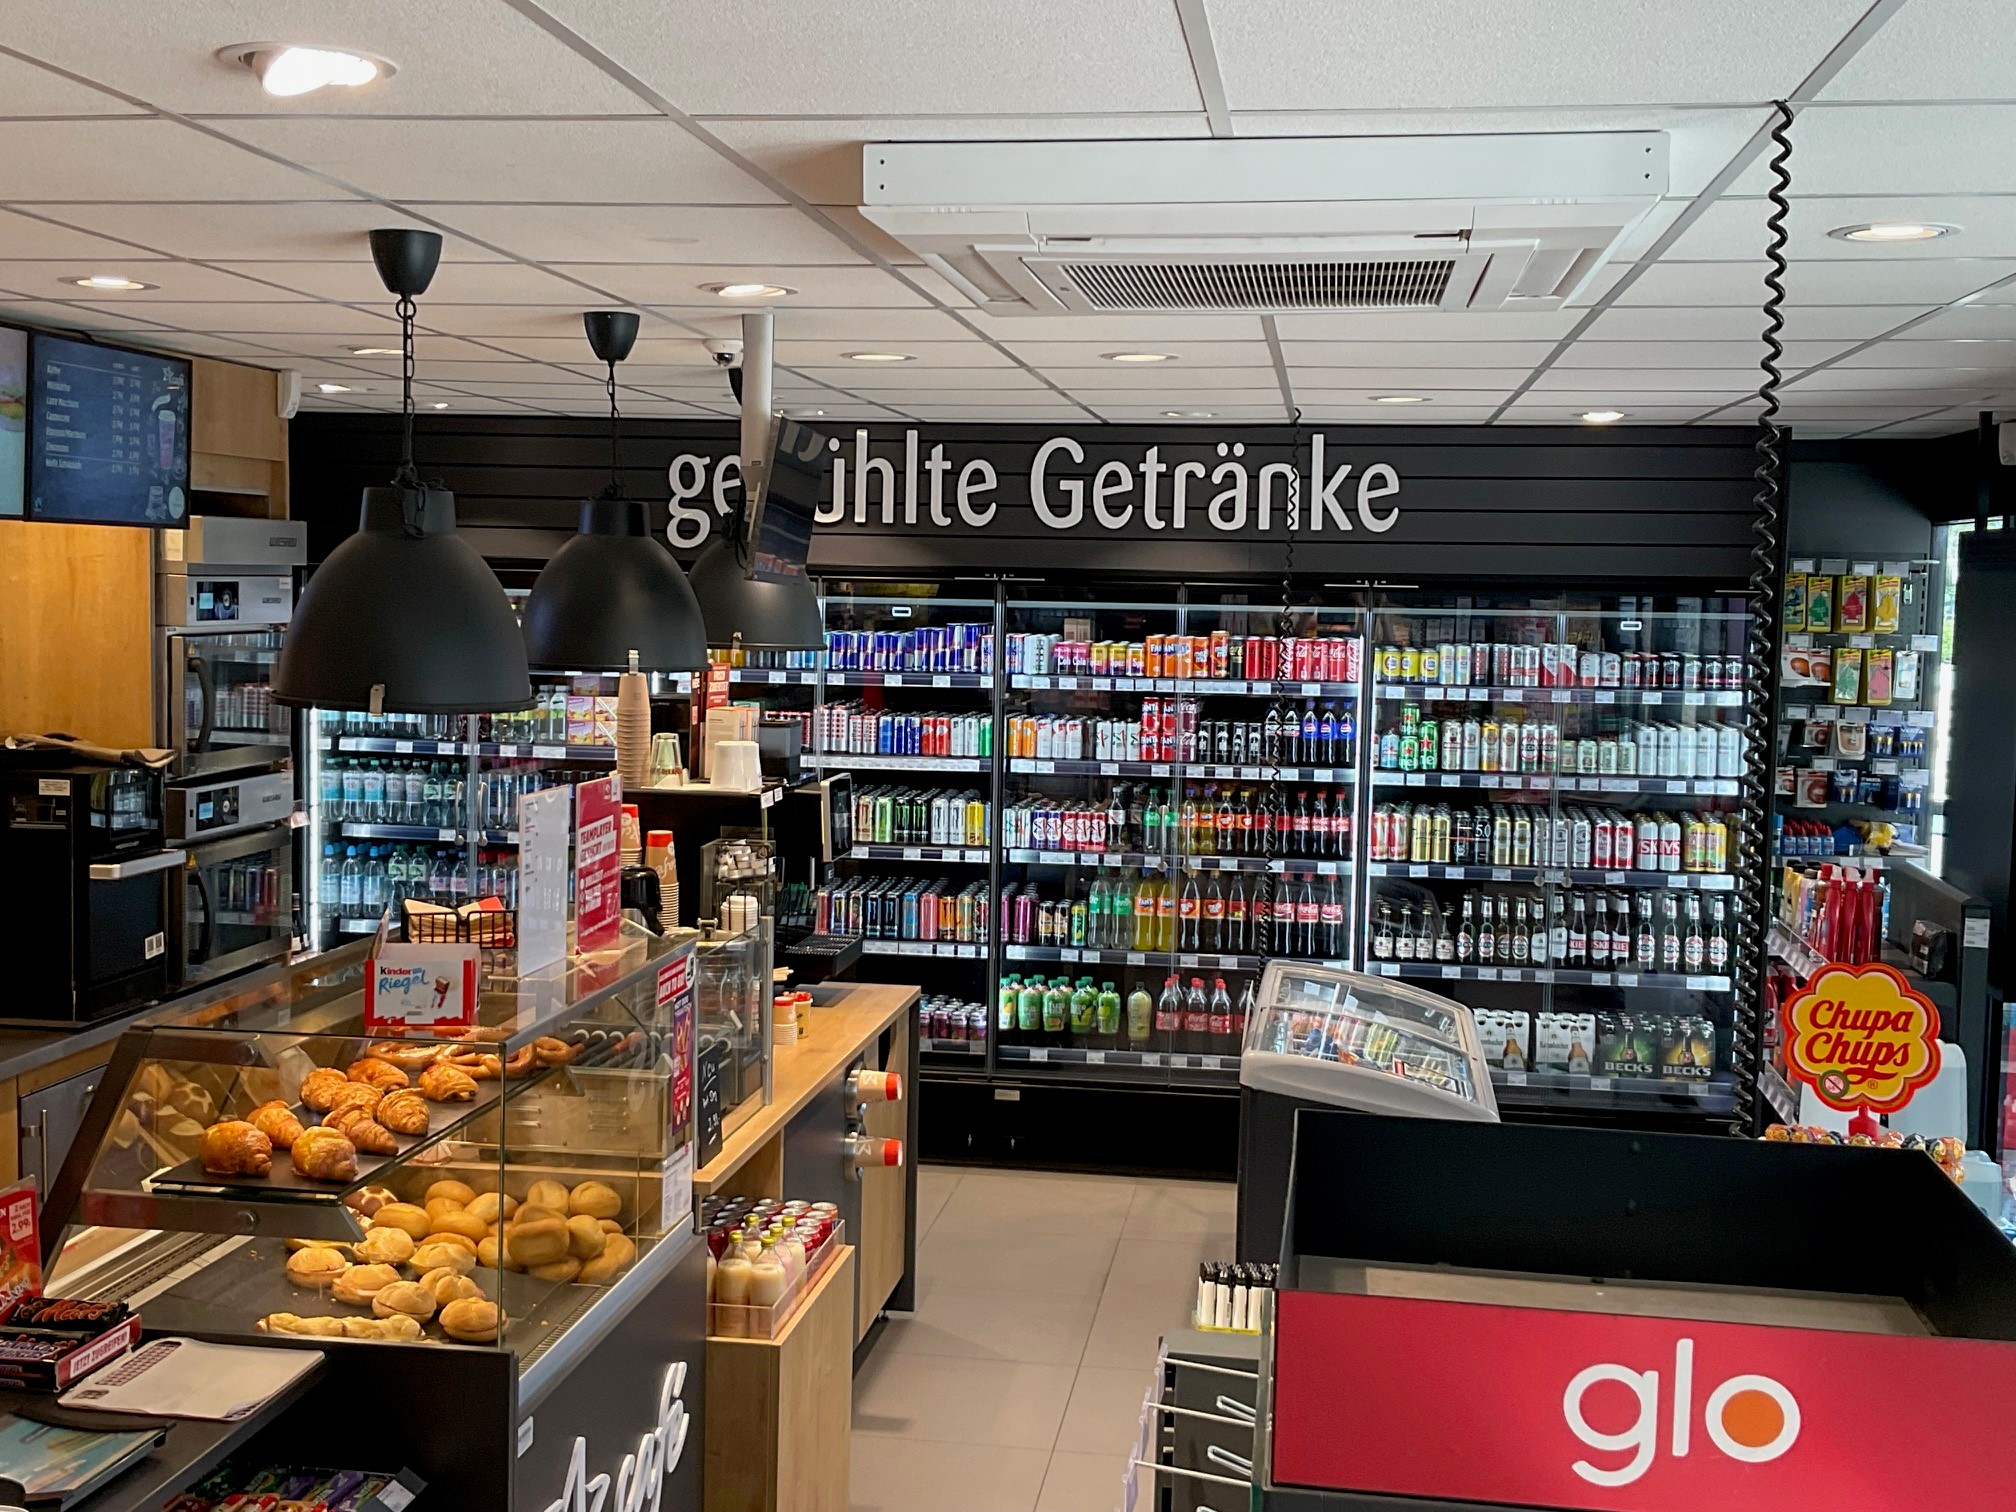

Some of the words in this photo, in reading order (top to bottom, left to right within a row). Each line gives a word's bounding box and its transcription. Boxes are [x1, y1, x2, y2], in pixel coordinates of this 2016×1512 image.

[1030, 432, 1401, 534] Getränke
[378, 969, 430, 996] Riegel
[1809, 999, 1914, 1040] Chupa
[1605, 1061, 1653, 1074] BECK'S
[1662, 1064, 1712, 1077] BECK'S
[1805, 1031, 1912, 1077] Chups
[1563, 1338, 1801, 1487] glo
